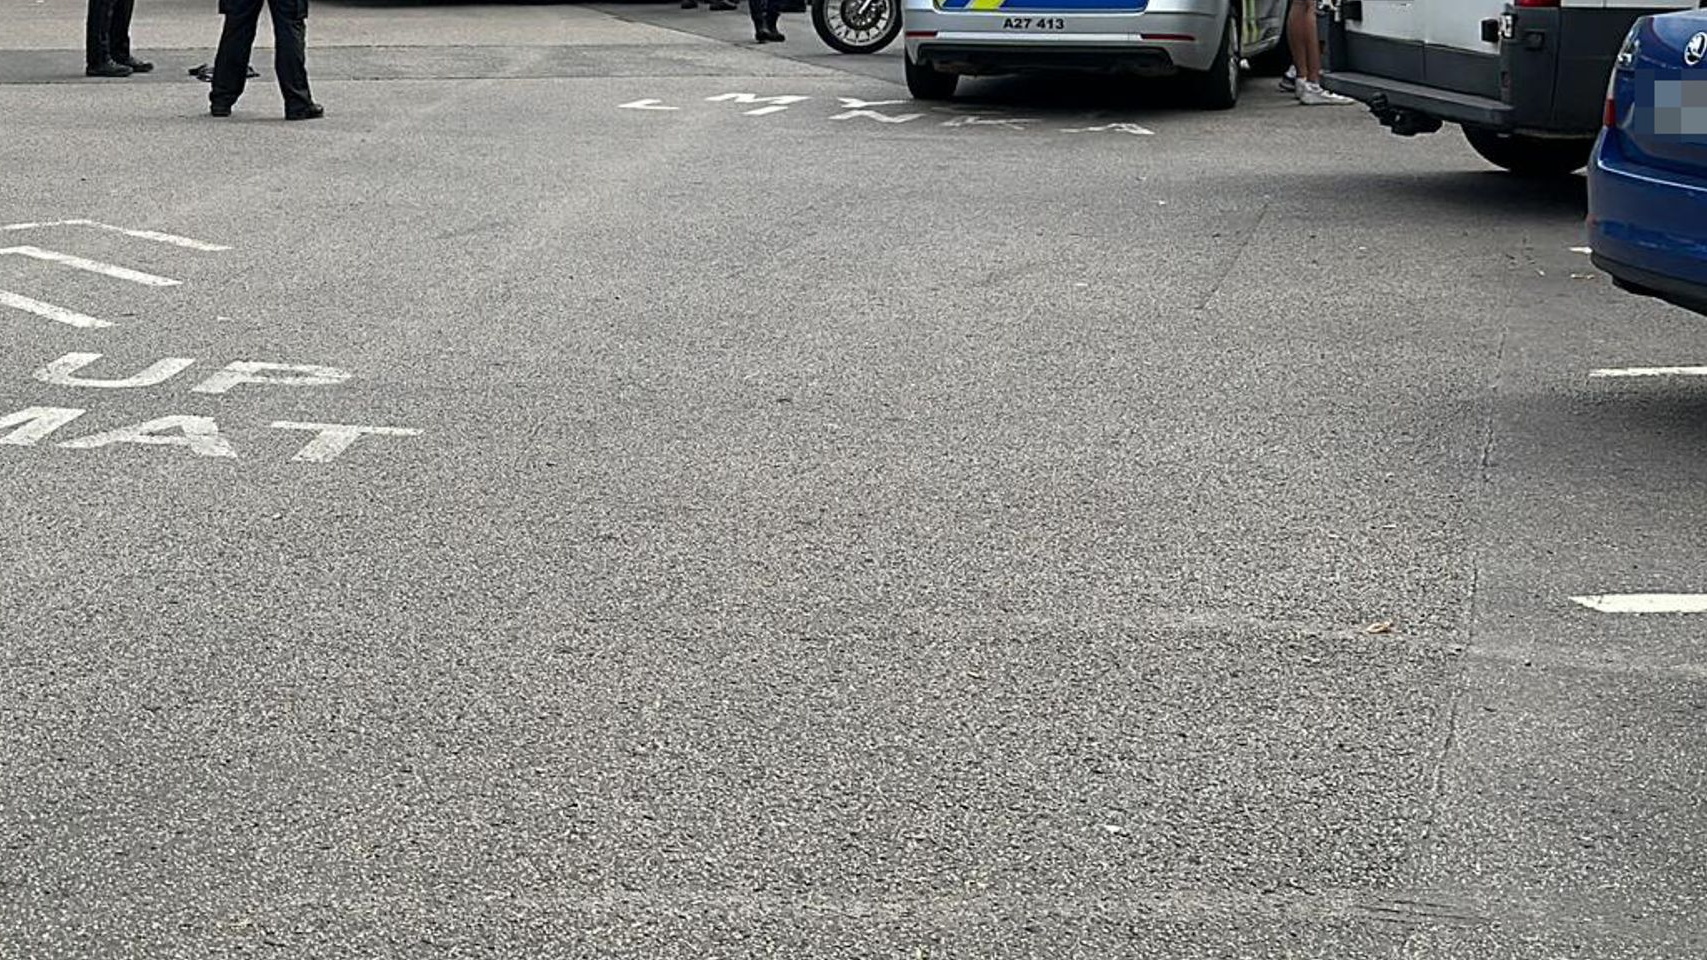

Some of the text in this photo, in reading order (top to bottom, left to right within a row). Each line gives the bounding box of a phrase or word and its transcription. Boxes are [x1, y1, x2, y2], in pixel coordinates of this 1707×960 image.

[1003, 18, 1065, 30] A27 413
[38, 350, 354, 394] UP
